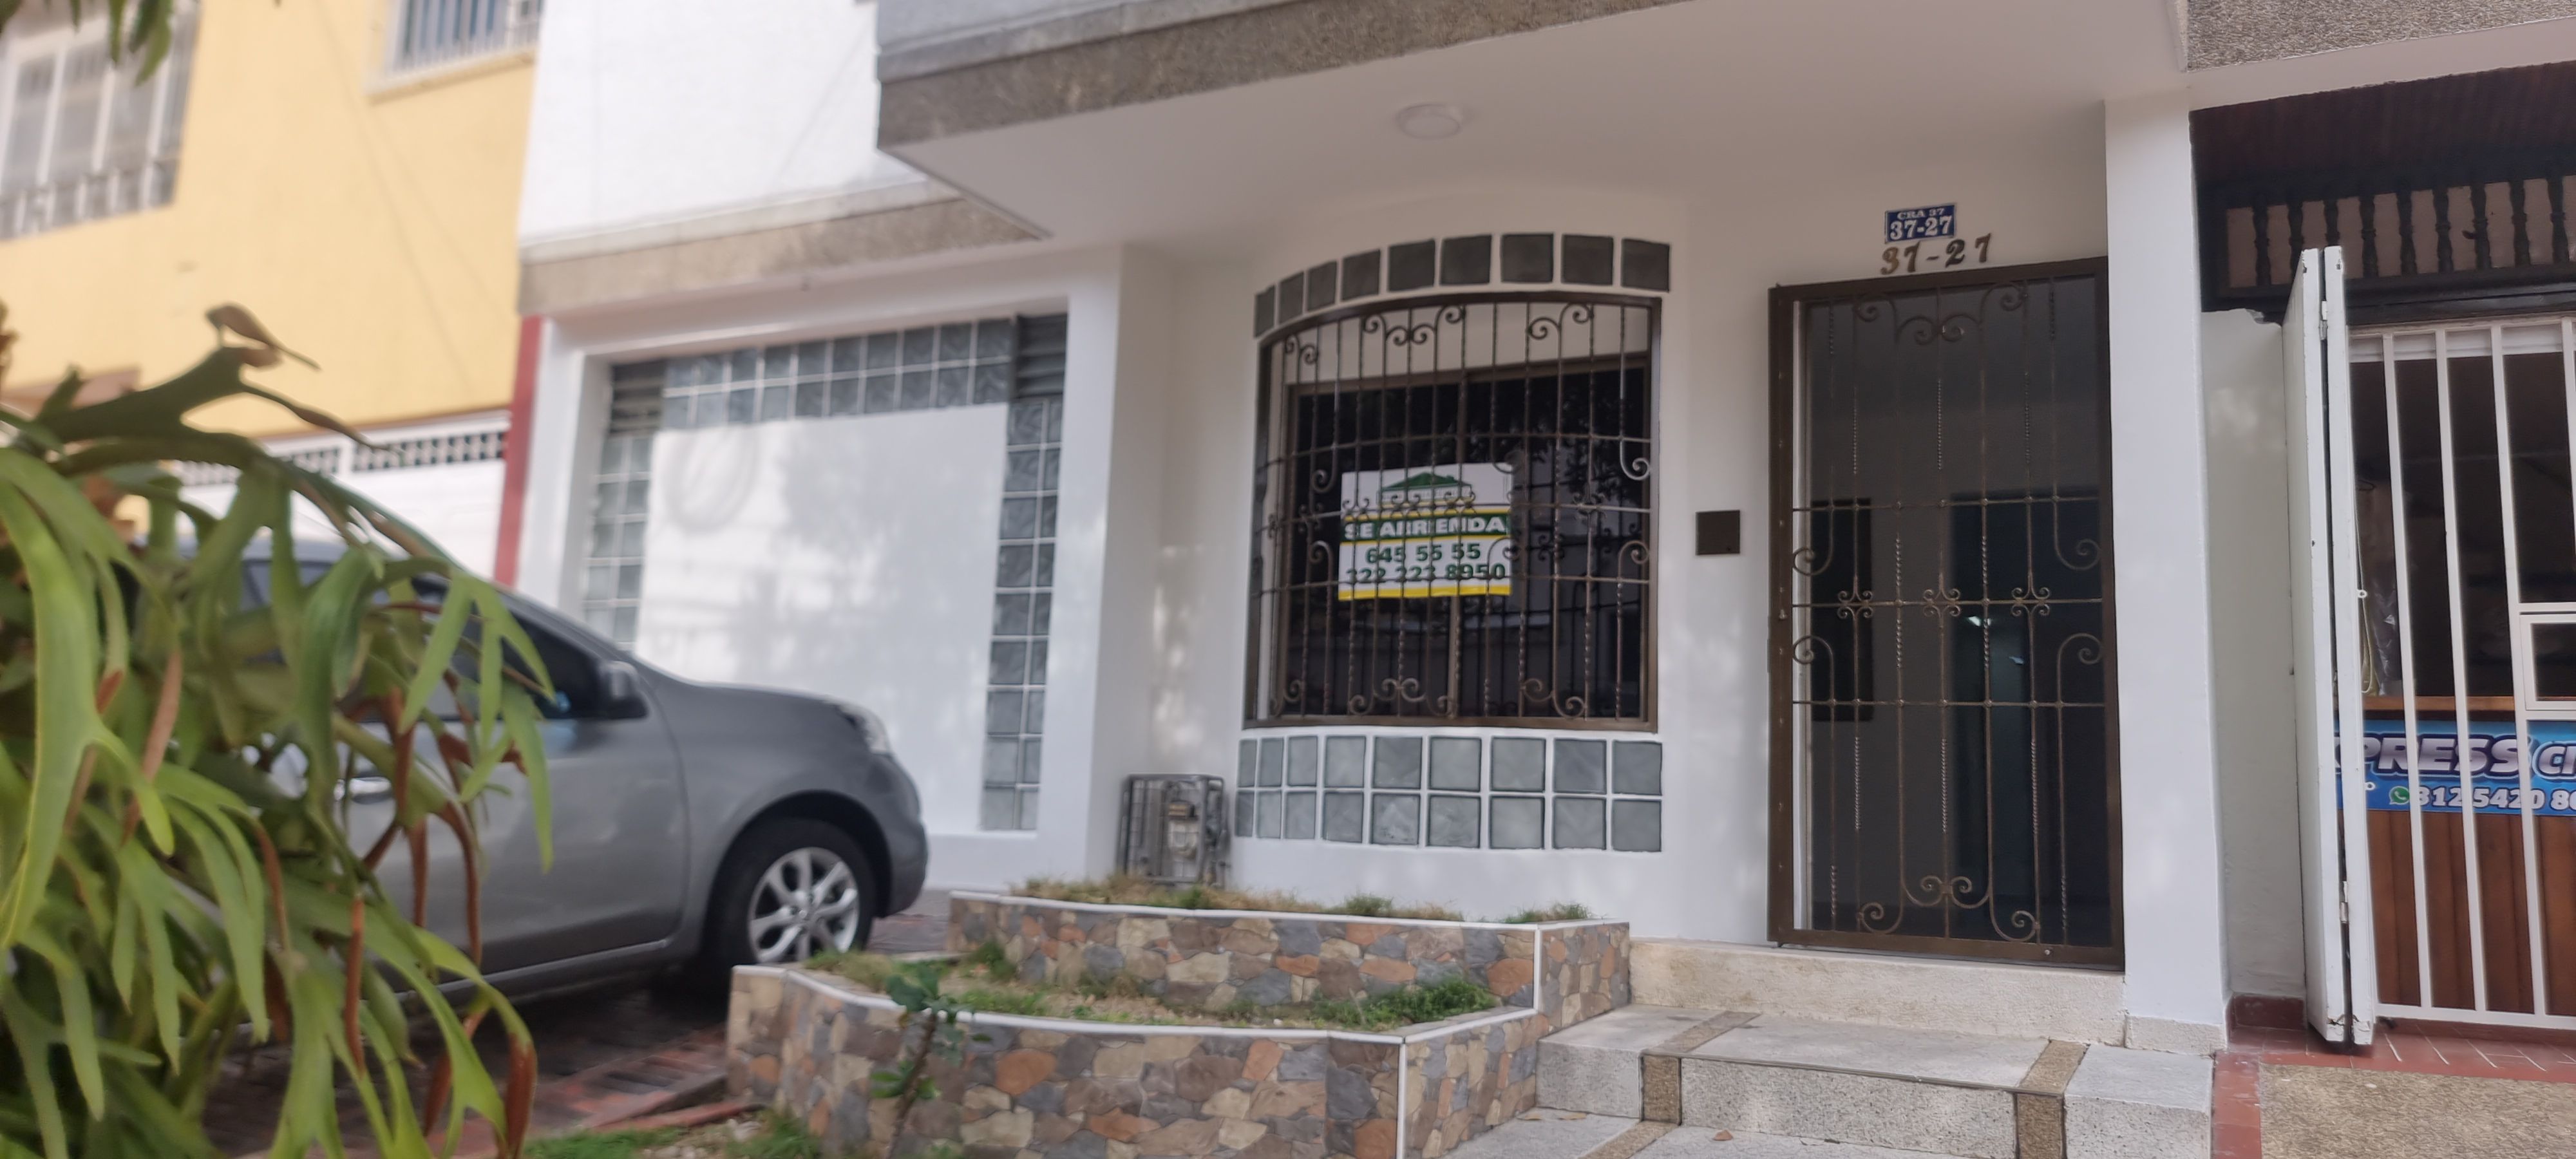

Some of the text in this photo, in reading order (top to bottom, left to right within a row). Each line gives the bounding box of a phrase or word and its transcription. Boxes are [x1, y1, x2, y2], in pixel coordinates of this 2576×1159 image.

[1897, 207, 1944, 220] CRA 37
[1889, 215, 1952, 240] 37-27
[1880, 233, 1992, 275] 37-27
[1344, 522, 1374, 540] SE
[1366, 543, 1481, 564] 645 55 55
[1446, 563, 1506, 580] 8950
[2334, 737, 2521, 773] PRESS
